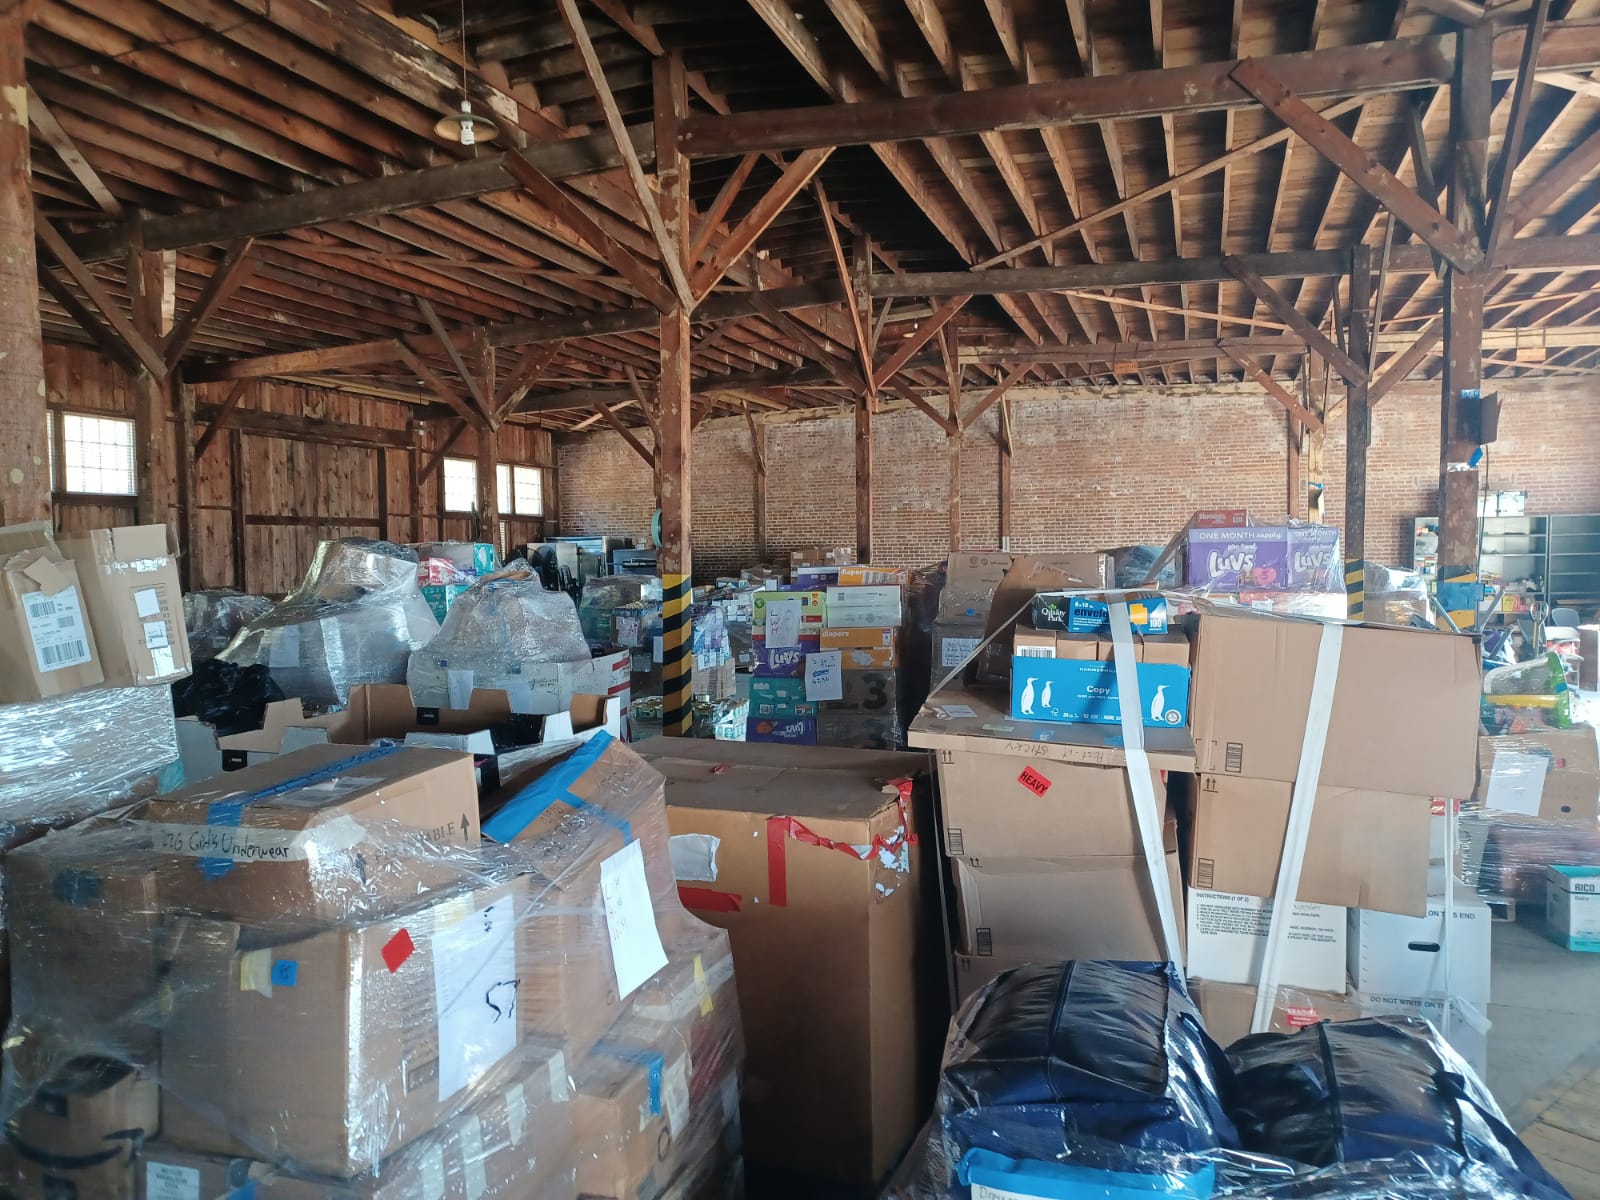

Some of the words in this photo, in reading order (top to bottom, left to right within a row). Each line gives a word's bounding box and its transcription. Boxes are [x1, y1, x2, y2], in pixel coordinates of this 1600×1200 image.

[1200, 532, 1218, 540] ONE
[1221, 532, 1256, 540] MONTH
[1041, 608, 1067, 617] Quality
[1074, 608, 1109, 618] envelo
[1047, 613, 1063, 622] Park
[1149, 618, 1162, 628] 100
[822, 630, 850, 638] diapers
[1086, 685, 1111, 695] Copy
[1019, 770, 1048, 794] HEAVY
[1399, 999, 1421, 1007] WRITE
